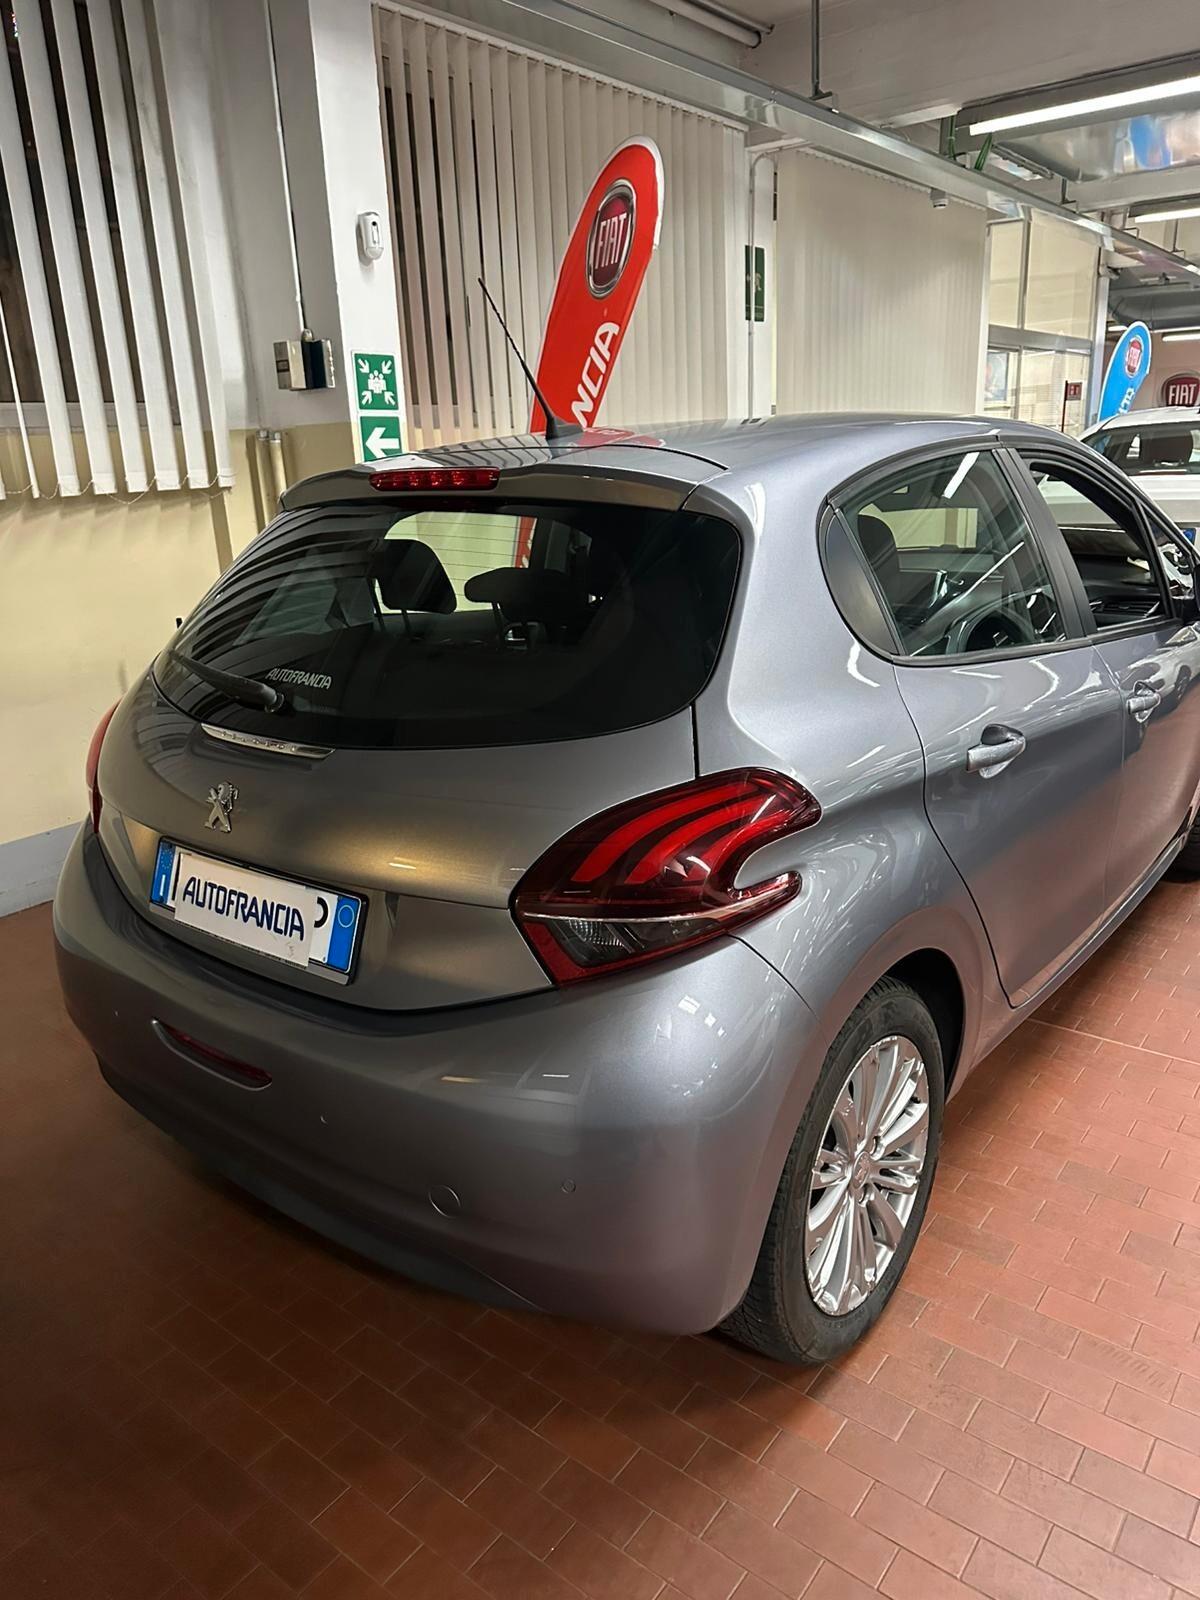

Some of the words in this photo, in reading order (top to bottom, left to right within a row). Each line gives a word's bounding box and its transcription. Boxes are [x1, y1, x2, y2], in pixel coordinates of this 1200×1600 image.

[594, 212, 628, 270] FIAT
[571, 321, 620, 428] NCIA
[1168, 383, 1197, 405] FIAT
[264, 667, 332, 690] AUTOFRANCIA
[182, 876, 305, 941] AUTOFRANCIA
